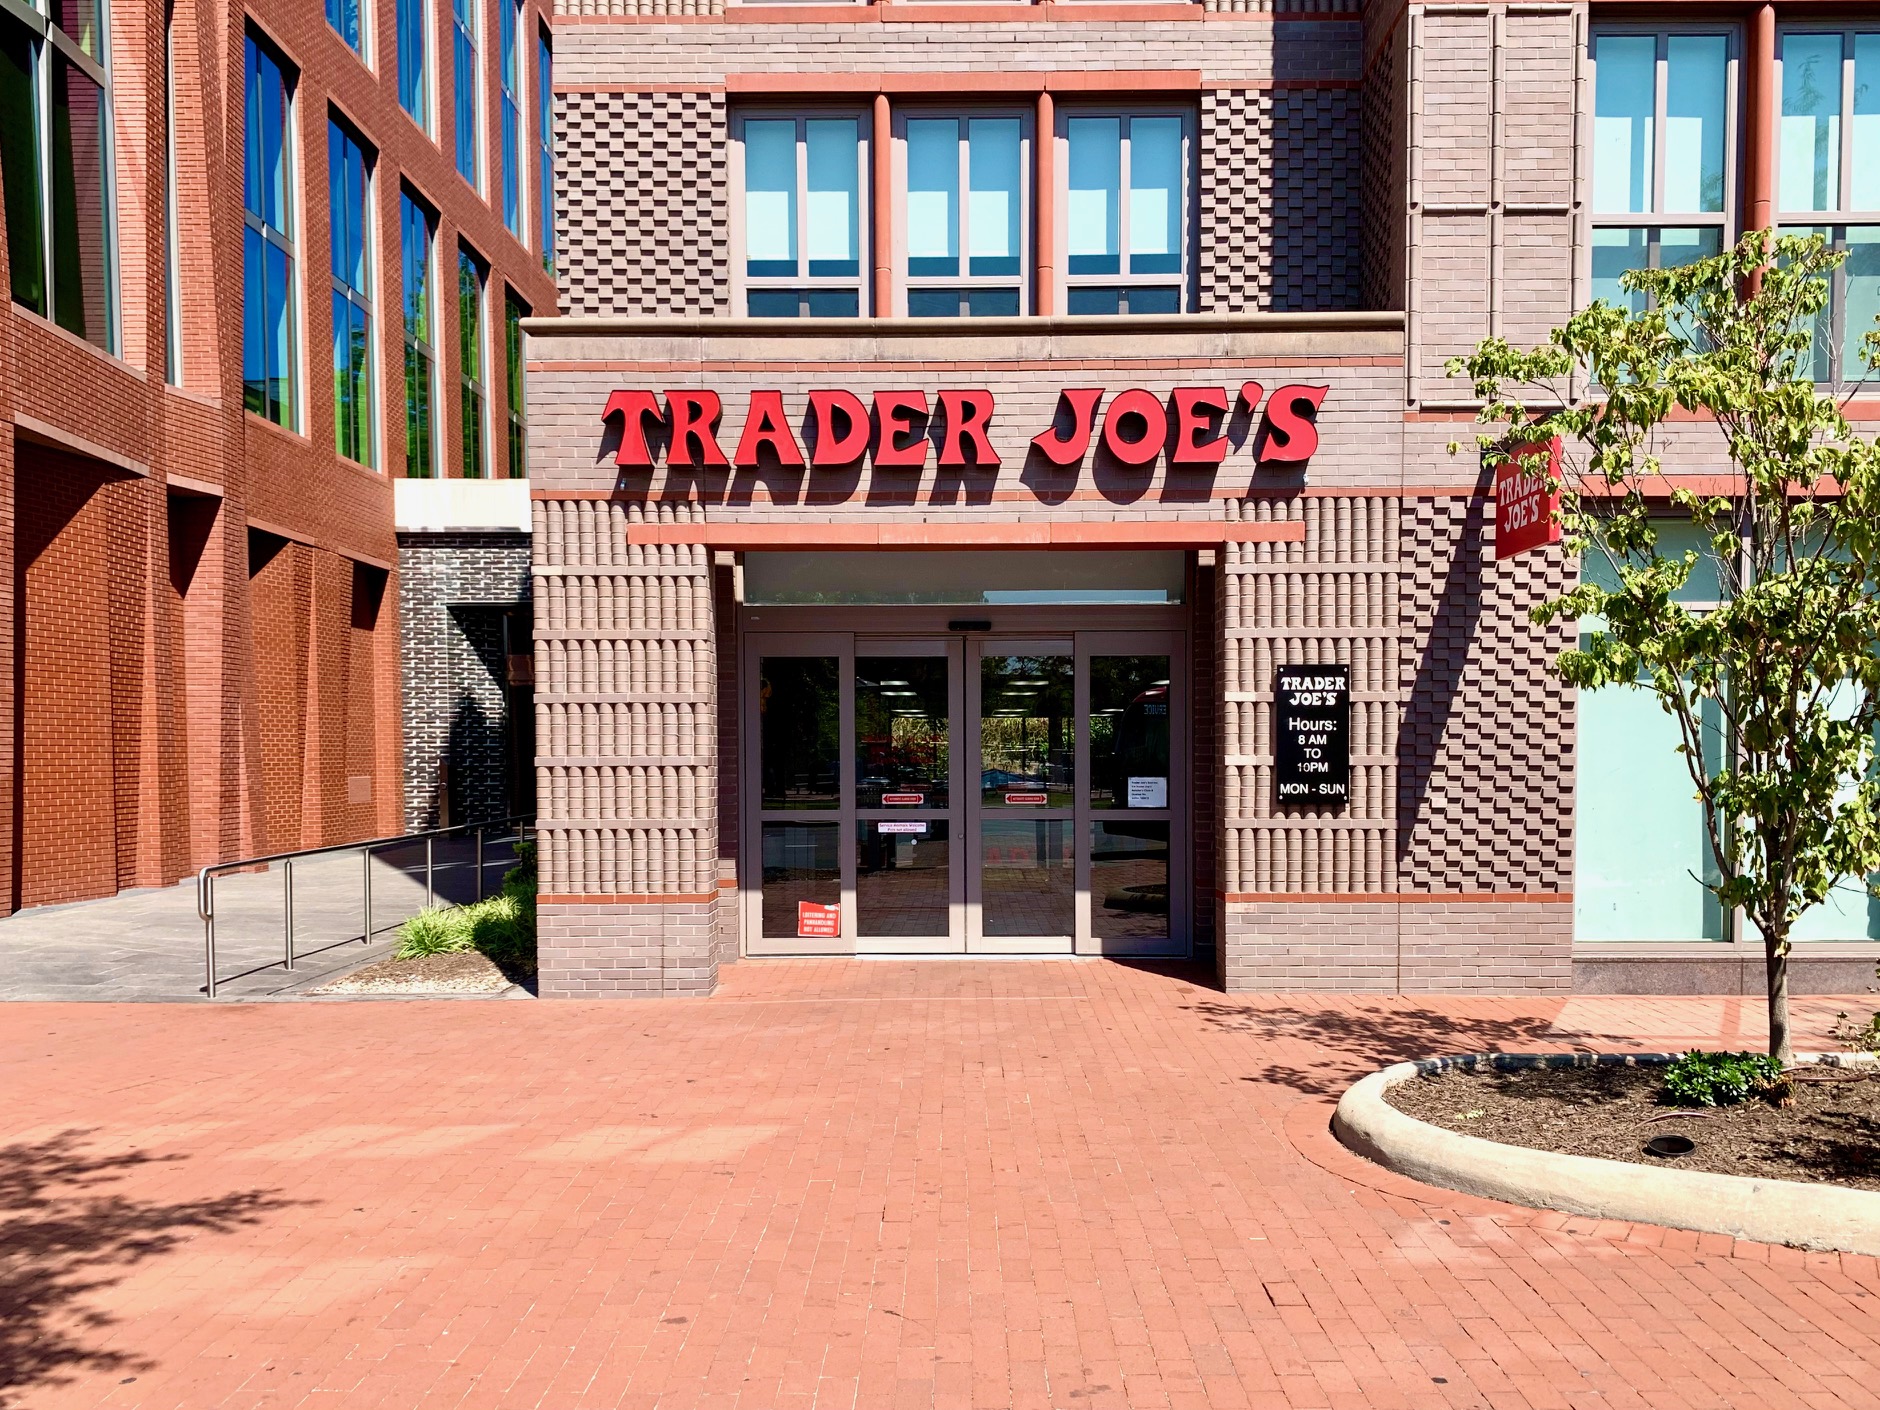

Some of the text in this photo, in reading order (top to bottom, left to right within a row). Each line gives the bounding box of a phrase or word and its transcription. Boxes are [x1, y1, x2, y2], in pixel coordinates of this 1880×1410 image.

[601, 380, 1331, 467] TRADER JOE'S
[1503, 493, 1541, 533] JOE'S
[1280, 676, 1346, 691] TRADER
[1289, 691, 1338, 706] JOE'S
[1288, 717, 1337, 731] Hours:
[1297, 734, 1327, 745] 8 AM
[1303, 748, 1322, 759] TO
[1297, 762, 1329, 773] 10PM
[1279, 783, 1309, 794] MON
[1318, 783, 1345, 794] SUN
